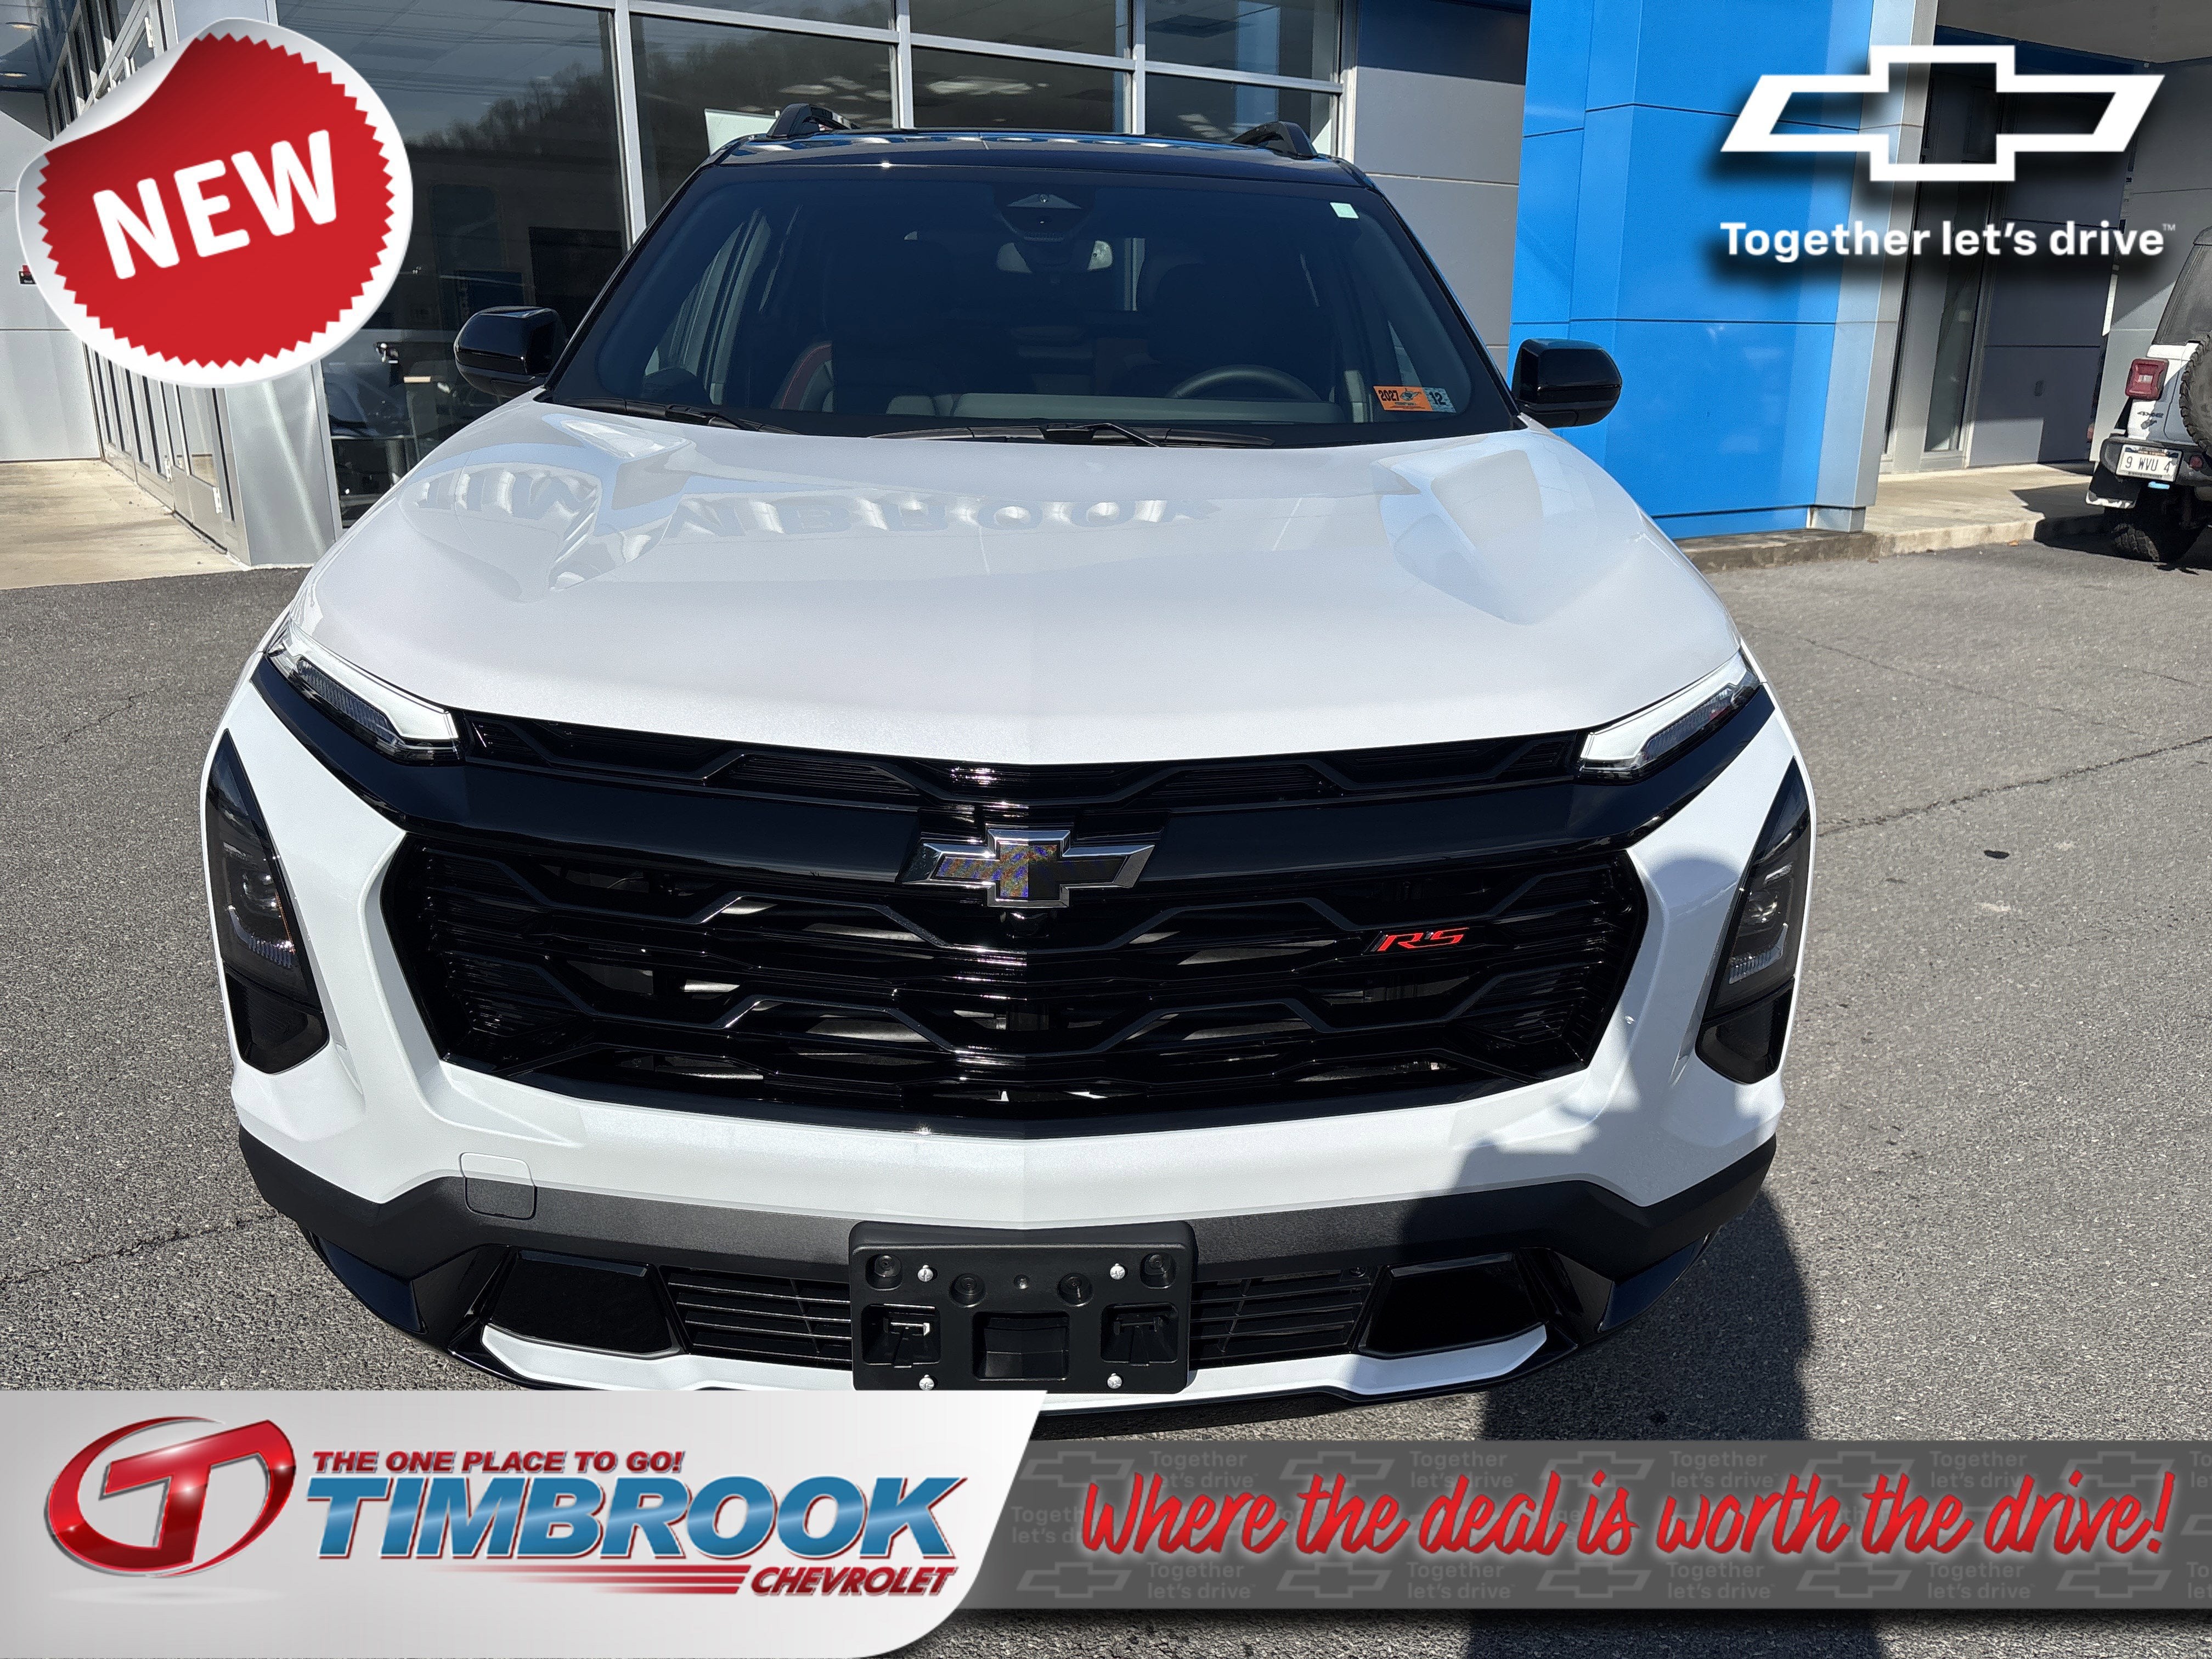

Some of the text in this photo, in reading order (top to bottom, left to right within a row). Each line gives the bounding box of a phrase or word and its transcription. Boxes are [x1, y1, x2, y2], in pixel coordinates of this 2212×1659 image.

[1378, 390, 1447, 405] 2027 12
[2125, 456, 2133, 469] 9
[2137, 457, 2159, 472] WVU
[1374, 927, 1470, 952] RS
